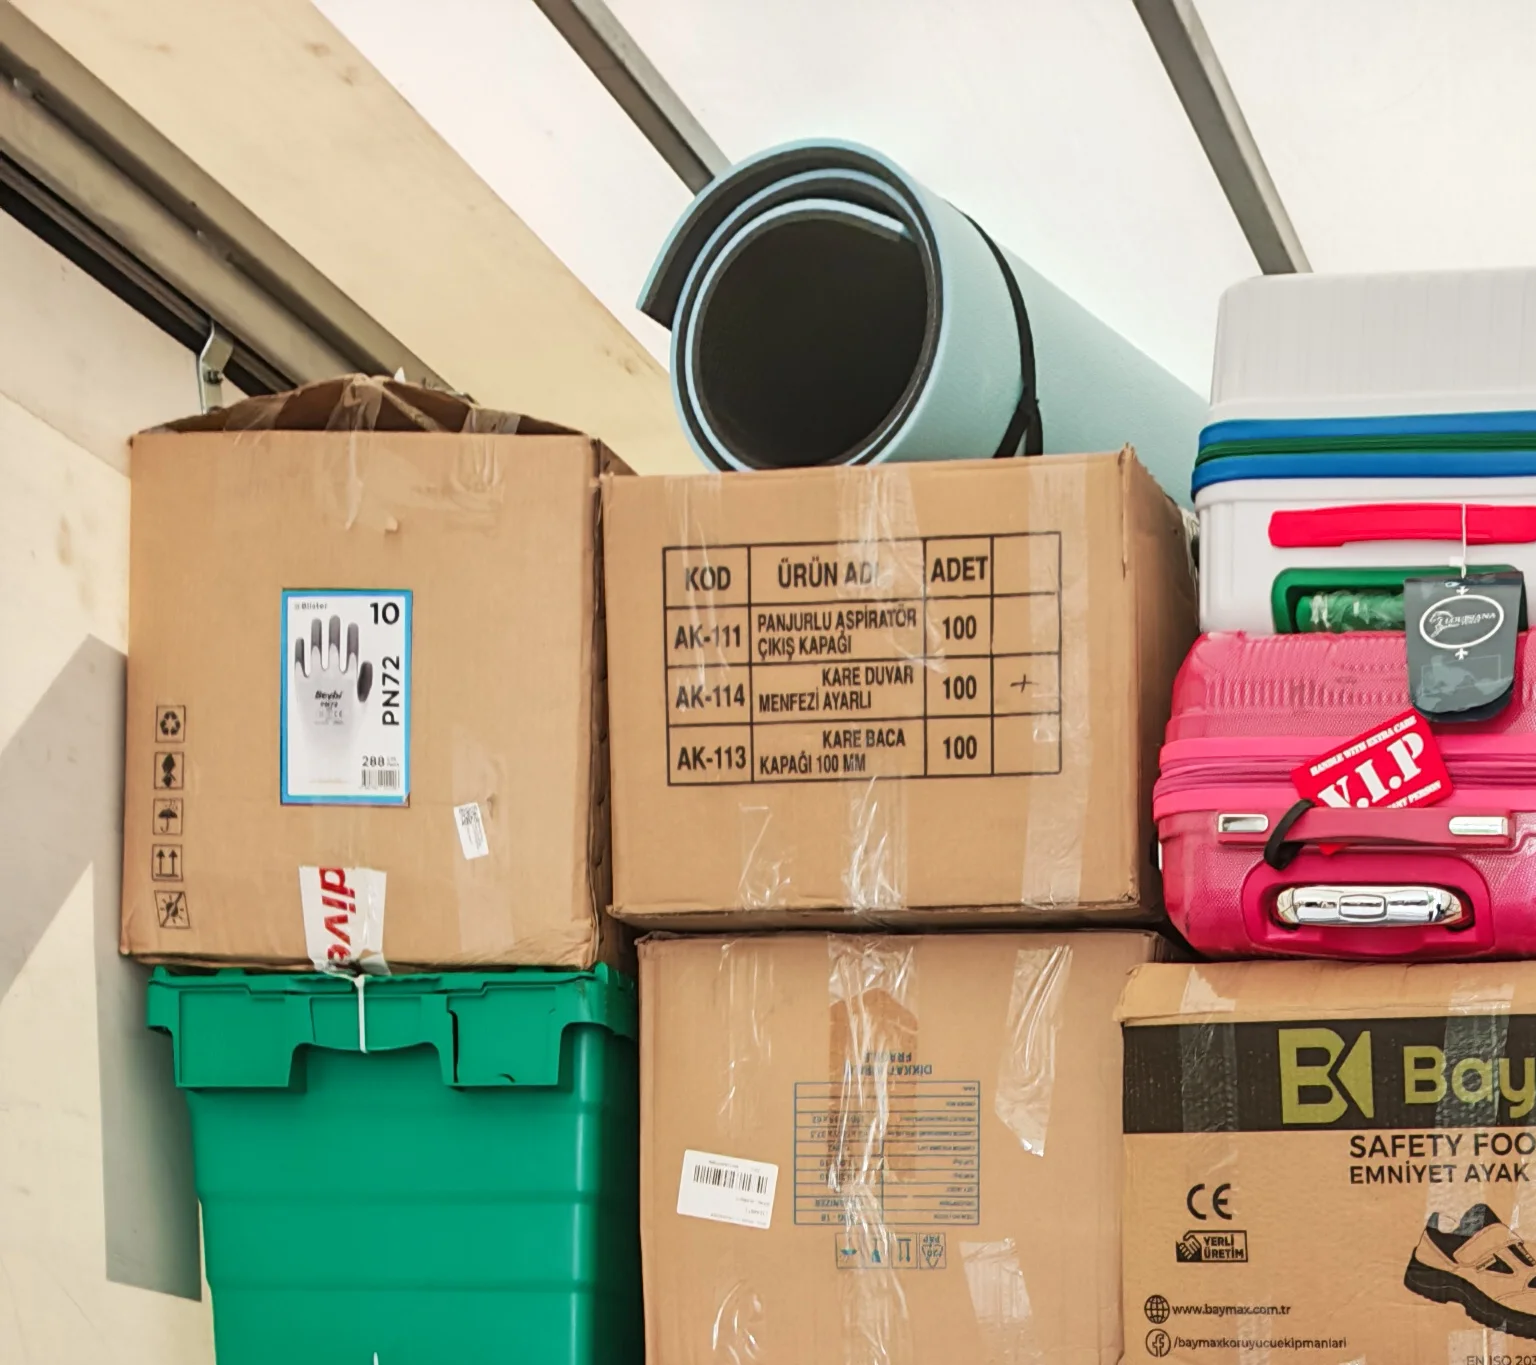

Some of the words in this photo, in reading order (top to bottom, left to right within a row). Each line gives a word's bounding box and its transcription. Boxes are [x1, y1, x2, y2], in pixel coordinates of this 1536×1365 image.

[685, 566, 731, 592] KOD
[778, 556, 837, 587] ÜRÜN
[931, 556, 988, 583] ADET
[370, 602, 400, 625] 10
[758, 610, 832, 633] PANJURLU
[835, 605, 917, 630] ASPİRATÖR
[674, 624, 742, 649] AK-111
[758, 635, 795, 660] ÇIKIŞ
[799, 632, 852, 656] KAPAĞI
[943, 616, 977, 639] 100
[822, 667, 862, 686] KARE
[865, 666, 914, 685] DUVAR
[382, 656, 400, 725] PN72
[676, 684, 745, 708] AK-114
[759, 688, 820, 713] MENFEZİ
[823, 688, 872, 710] AYARLI
[943, 676, 977, 700] 100
[822, 729, 862, 749] KARE
[866, 729, 906, 748] BACA
[677, 745, 747, 770] AK-113
[760, 751, 813, 775] KAPAĞI
[816, 754, 839, 774] 100
[843, 754, 866, 773] MM
[943, 736, 978, 760] 100
[1350, 1133, 1462, 1158] SAFETY
[1350, 1159, 1454, 1185] EMNİYET
[1465, 1162, 1528, 1182] AYAK
[1203, 1234, 1234, 1247] YERLİ
[1203, 1247, 1244, 1260] ÜRETİM
[1172, 1303, 1291, 1317] www.baymax.com.tr
